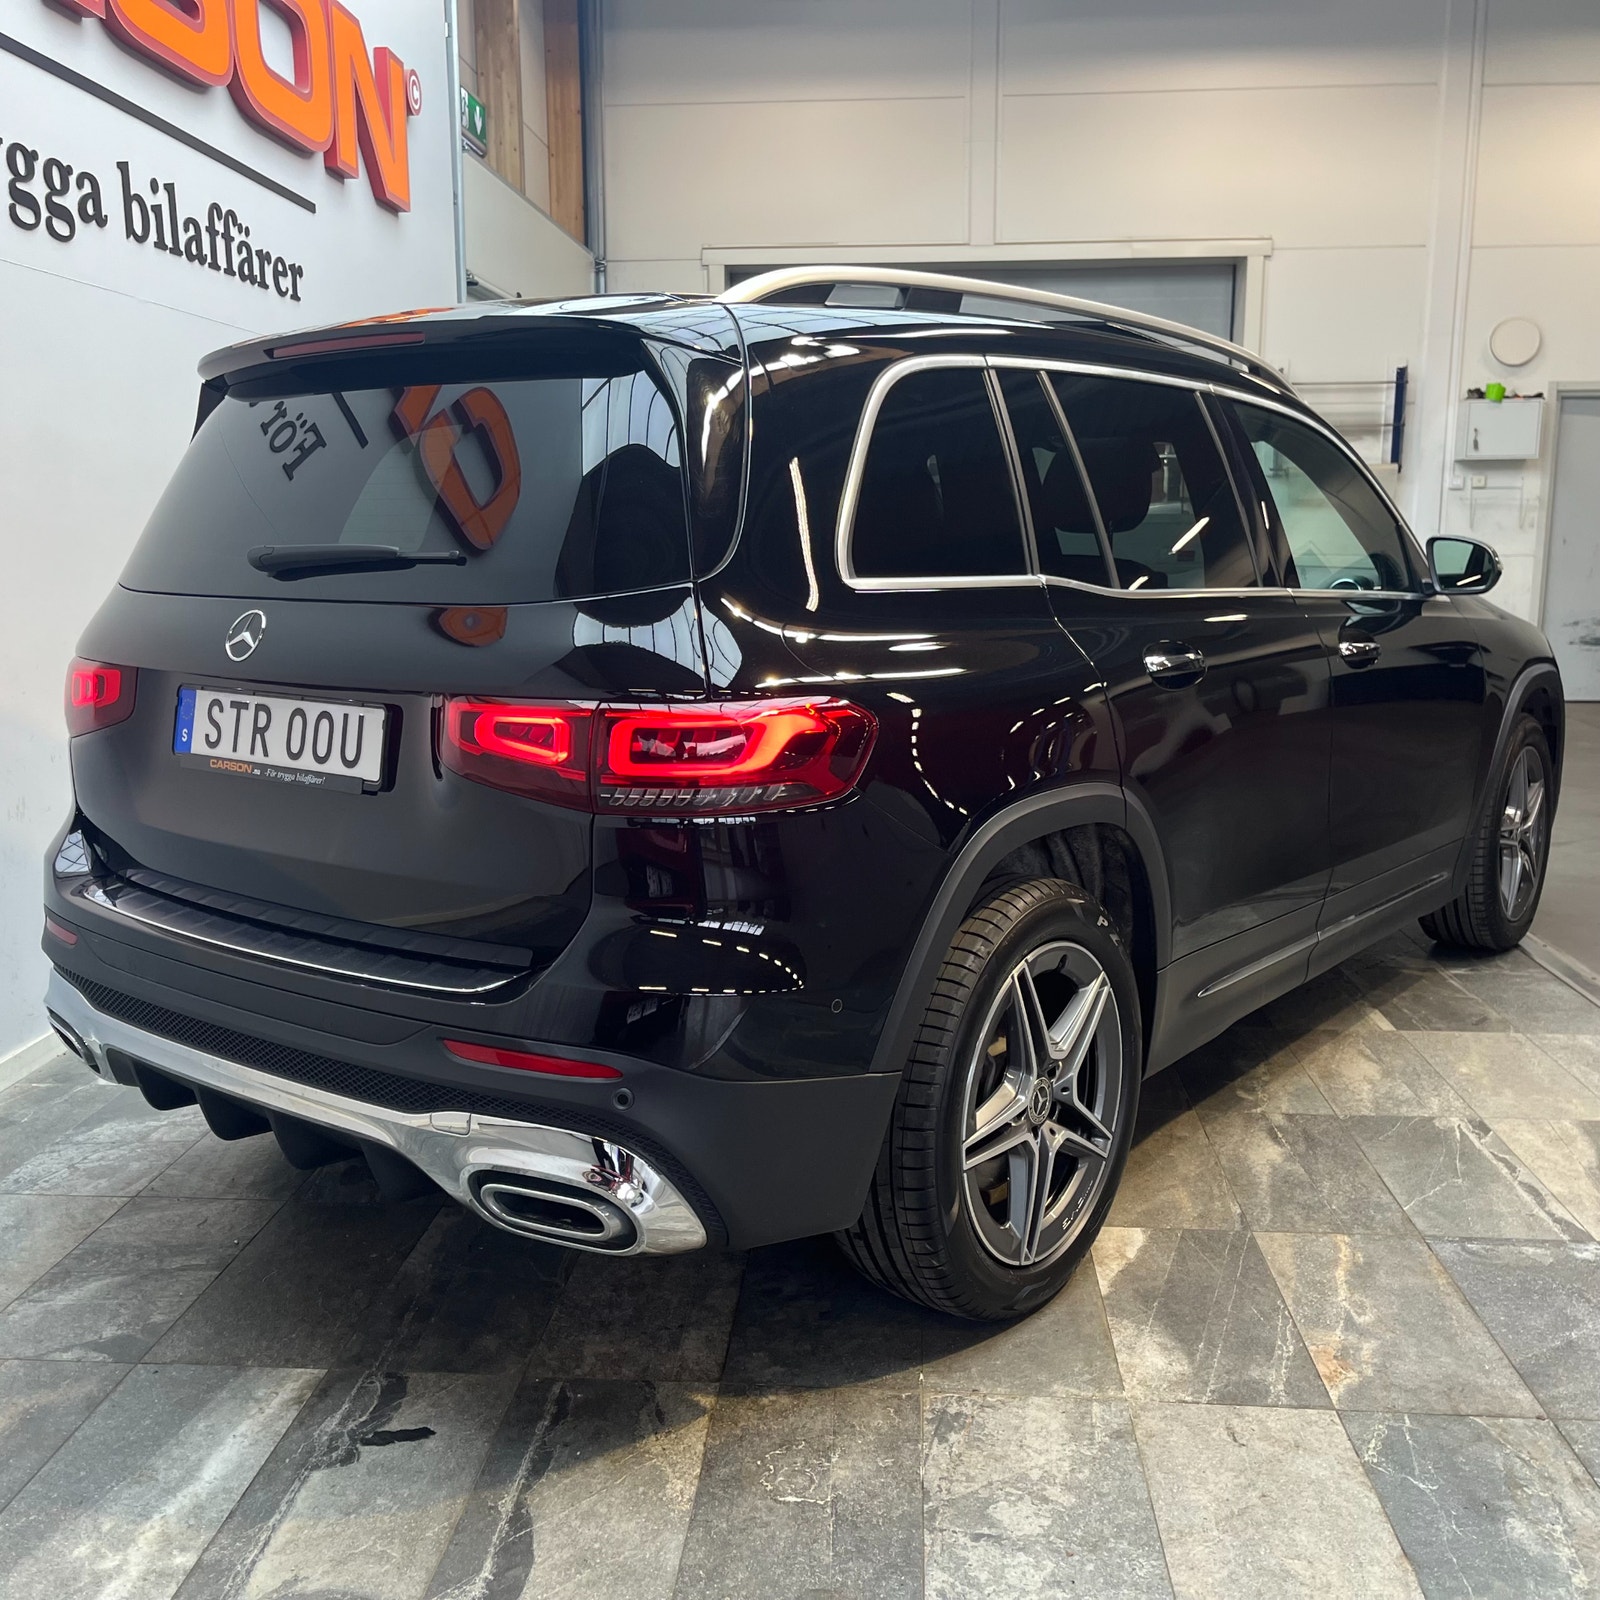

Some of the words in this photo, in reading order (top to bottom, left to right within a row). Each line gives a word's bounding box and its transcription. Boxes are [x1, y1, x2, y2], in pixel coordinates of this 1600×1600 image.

[0, 137, 108, 243] gga
[117, 161, 303, 301] bilaffärer
[181, 728, 188, 742] S
[204, 698, 272, 757] STR
